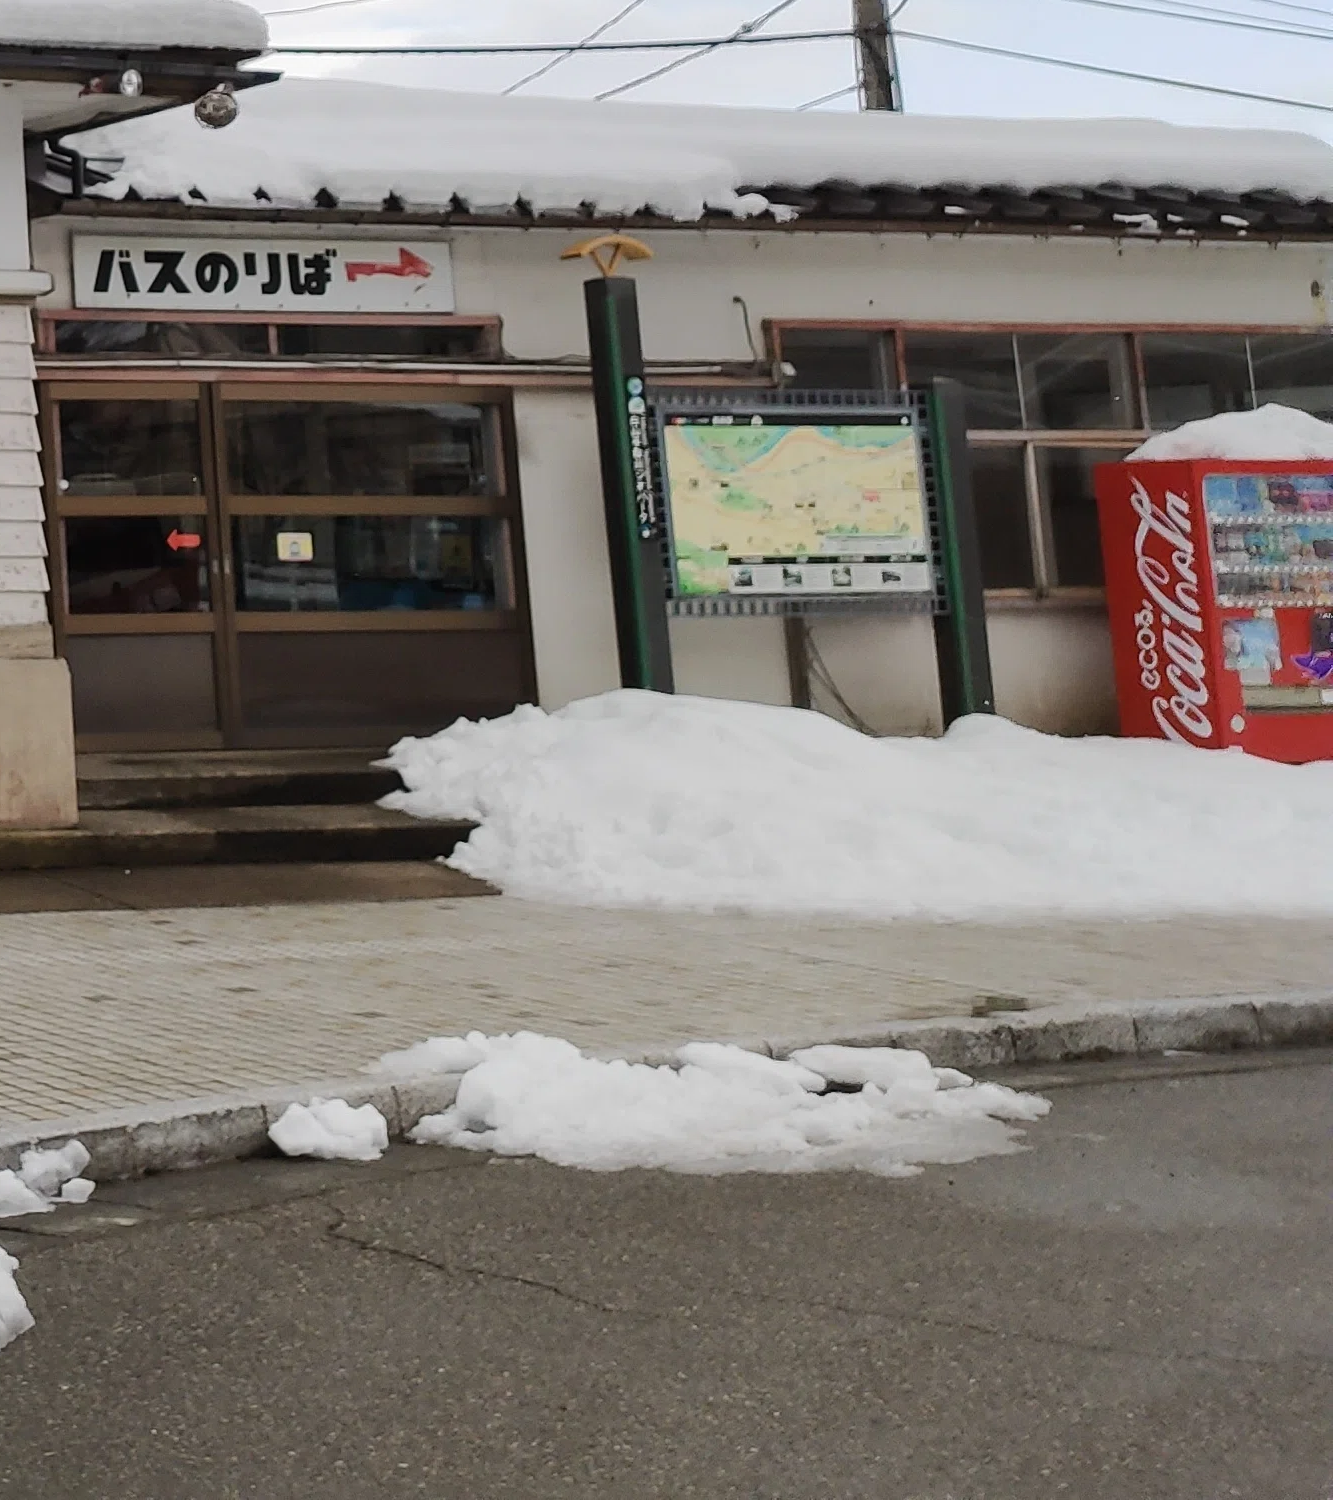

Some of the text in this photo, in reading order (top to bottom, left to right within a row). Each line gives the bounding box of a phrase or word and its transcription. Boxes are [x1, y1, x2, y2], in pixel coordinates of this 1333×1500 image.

[94, 248, 337, 296] バスのりば
[1130, 474, 1213, 743] Coca-Cola
